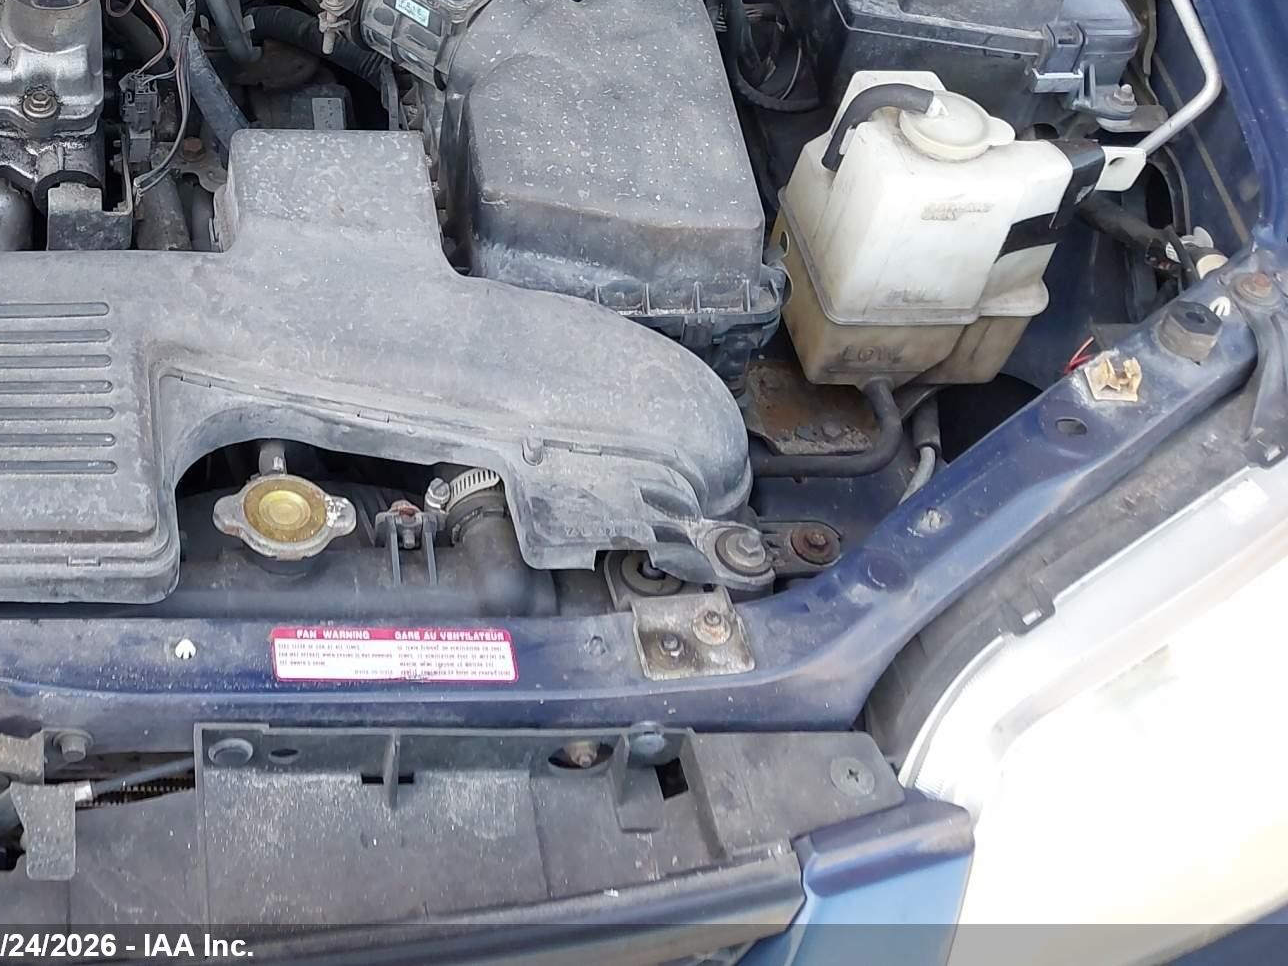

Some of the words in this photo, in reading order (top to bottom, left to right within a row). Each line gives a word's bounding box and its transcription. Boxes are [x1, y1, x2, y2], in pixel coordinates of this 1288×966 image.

[296, 630, 317, 639] FAN
[322, 630, 371, 640] WARNING
[394, 630, 421, 641] GARE
[423, 631, 437, 641] AU
[439, 631, 505, 641] VENTILATEUR
